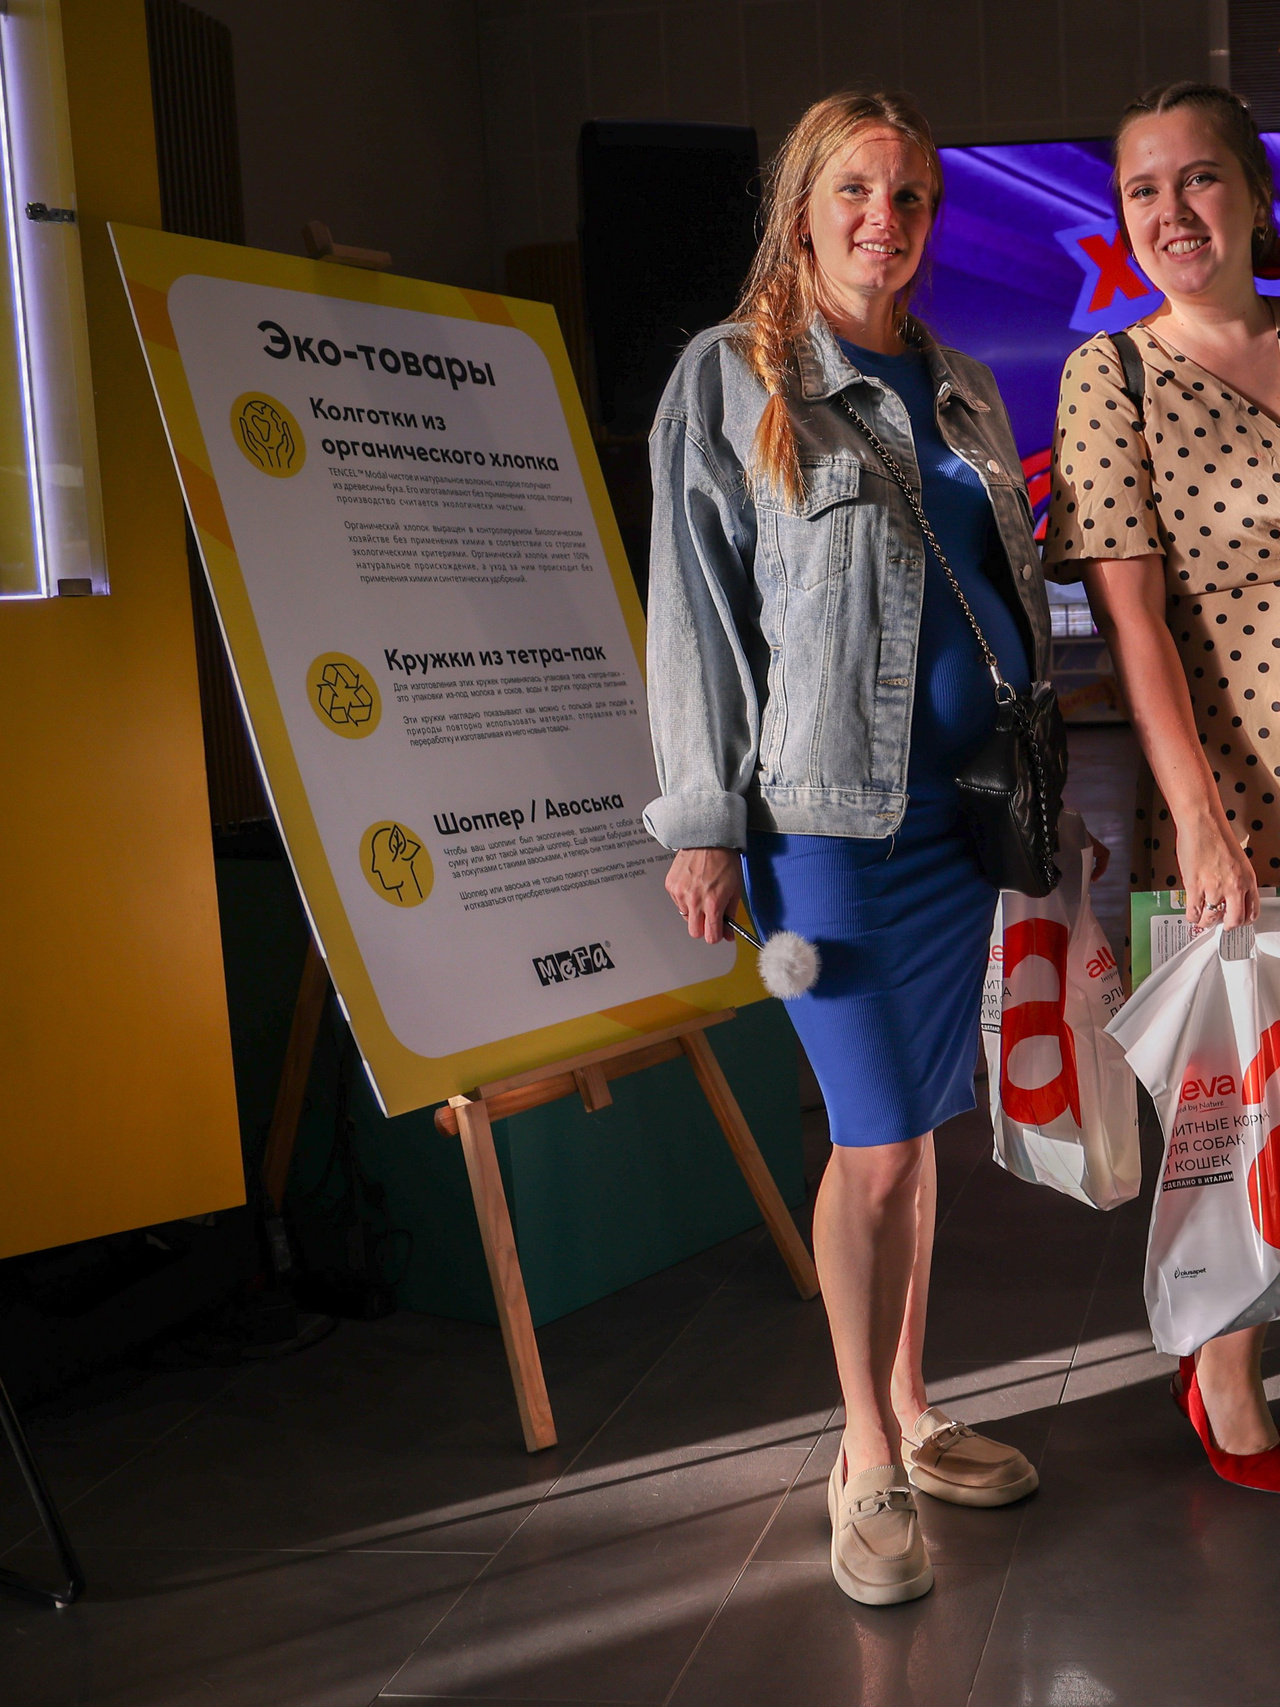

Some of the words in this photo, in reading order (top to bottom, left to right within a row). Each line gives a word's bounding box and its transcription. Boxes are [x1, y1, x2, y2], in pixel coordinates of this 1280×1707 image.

[257, 320, 496, 391] Эко-товары
[309, 397, 418, 428] Колготки
[423, 413, 447, 432] из
[321, 438, 486, 466] органического
[491, 452, 559, 471] хлопка
[365, 470, 388, 479] Modal
[388, 473, 414, 481] чистое
[420, 476, 464, 484] натуральное
[496, 480, 521, 489] которое
[522, 482, 552, 490] получают
[332, 482, 342, 490] из
[344, 483, 386, 492] древесины
[386, 484, 406, 494] бука.
[407, 486, 418, 494] Его
[420, 488, 472, 497] изготавливают
[472, 489, 484, 498] без
[485, 491, 525, 500] применения
[548, 495, 573, 504] поэтому
[336, 496, 396, 506] производство
[400, 498, 438, 507] считается
[442, 500, 494, 510] экологически
[344, 520, 400, 530] Органический
[404, 524, 429, 532] хлопок
[432, 525, 466, 534] выращен
[476, 527, 532, 536] контролируемом
[534, 528, 582, 536] биологическом
[348, 534, 390, 544] хозяйстве
[393, 535, 407, 544] без
[411, 537, 459, 545] применения
[421, 550, 468, 558] критериями.
[471, 550, 521, 559] Органический
[573, 552, 590, 560] 100%
[356, 562, 411, 571] натуральное
[414, 563, 478, 572] происхождение,
[489, 564, 507, 572] уход
[538, 564, 578, 572] происходит
[581, 564, 593, 572] без
[360, 576, 408, 584] применения
[384, 649, 475, 675] Кружки
[479, 650, 503, 666] из
[506, 646, 606, 668] тетра-пак
[393, 683, 408, 692] Для
[411, 680, 457, 690] изготовления
[501, 677, 541, 685] применялась
[543, 674, 570, 683] упаковка
[411, 693, 443, 703] упаковки
[446, 691, 469, 699] из-под
[573, 682, 602, 691] продуктов
[403, 716, 417, 724] Эти
[421, 714, 446, 724] кружки
[449, 711, 480, 720] наглядно
[484, 708, 522, 717] показывают
[568, 702, 592, 710] пользой
[608, 699, 627, 707] людей
[406, 727, 442, 736] природы
[446, 722, 482, 731] повторно
[486, 718, 536, 728] использовать
[578, 712, 613, 720] отправляя
[410, 735, 457, 747] переработку
[460, 731, 504, 741] изготавливая
[433, 806, 525, 836] Шоппер
[531, 800, 536, 823] /
[545, 793, 624, 820] Авоська
[443, 845, 468, 856] Чтобы
[488, 839, 516, 850] шоппинг
[519, 836, 533, 844] был
[580, 824, 607, 834] возьмите
[616, 818, 633, 827] собой
[448, 860, 469, 869] сумку
[499, 849, 518, 858] такой
[520, 844, 545, 855] модный
[573, 837, 588, 846] Ещё
[606, 829, 632, 840] бабушки
[452, 871, 460, 879] за
[461, 865, 497, 877] покупками
[503, 859, 527, 869] такими
[527, 854, 563, 865] авоськами,
[568, 849, 590, 857] теперь
[616, 839, 646, 849] актуальны
[459, 889, 488, 900] Шоппер
[504, 880, 531, 891] авоська
[542, 874, 564, 883] только
[565, 870, 589, 879] помогут
[591, 863, 625, 875] сэкономить
[626, 858, 646, 868] деньги
[470, 897, 506, 910] отказаться
[508, 894, 516, 902] от
[515, 886, 560, 901] приобретения
[561, 878, 600, 891] одноразовых
[600, 873, 624, 882] пакетов
[1086, 946, 1117, 978] all
[1102, 986, 1124, 1005] ЭЛ
[1180, 1074, 1236, 1104] eva
[1188, 1102, 1198, 1112] by
[1200, 1100, 1224, 1110] Nature
[1172, 1117, 1229, 1139] ИТНЫЕ
[1167, 1142, 1188, 1159] ЛЯ
[1193, 1134, 1245, 1151] СОБАК
[1175, 1154, 1231, 1172] КОШЕК
[1163, 1180, 1195, 1190] СДЕЛАНО
[1204, 1173, 1233, 1183] ИТАЛИИ
